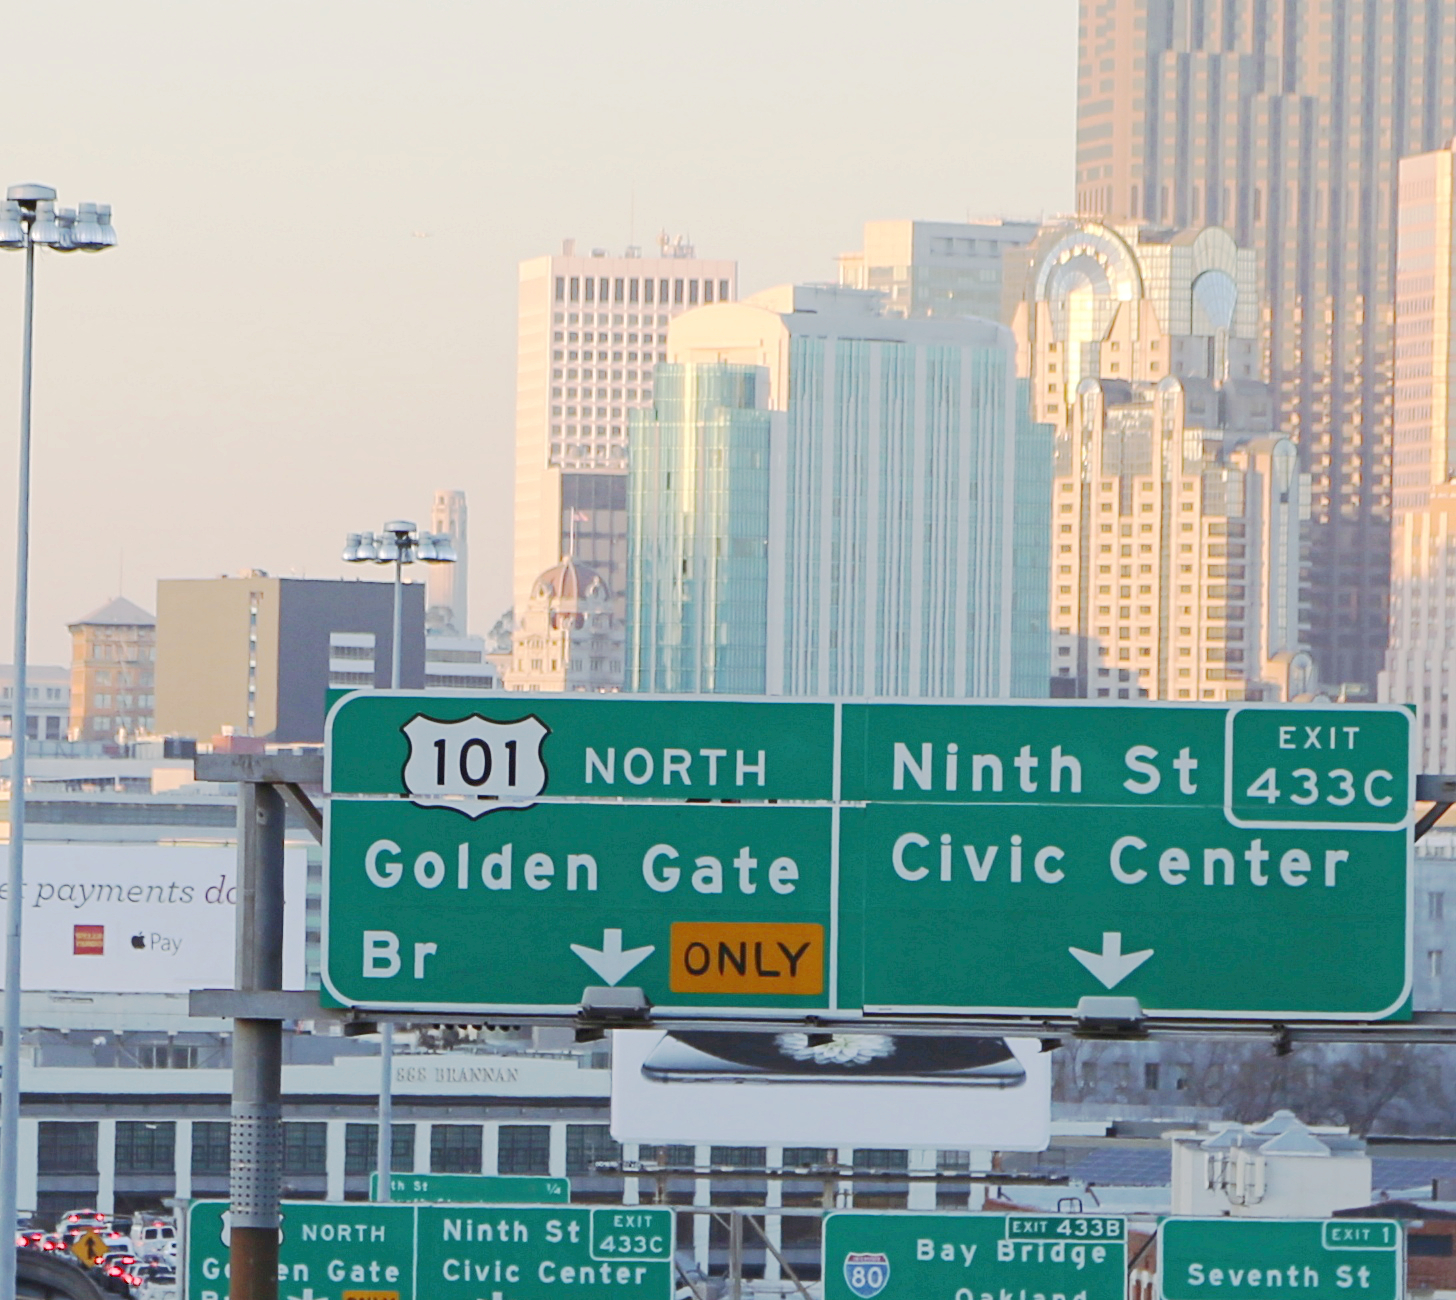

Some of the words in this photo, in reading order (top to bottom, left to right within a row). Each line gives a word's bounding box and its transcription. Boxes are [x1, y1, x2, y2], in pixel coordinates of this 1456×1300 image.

[1277, 724, 1361, 752] EXIT
[429, 738, 523, 789] 101
[582, 746, 768, 788] NORTH
[892, 742, 1085, 797] Ninth
[1124, 743, 1200, 798] St
[1244, 767, 1395, 809] 433C
[364, 839, 600, 894] Golden
[641, 843, 801, 896] Gate
[891, 832, 1067, 887] Civic
[1108, 835, 1352, 889] Center
[33, 878, 196, 908] payments
[150, 932, 182, 956] Pay
[361, 930, 438, 980] Br
[683, 939, 811, 980] ONLY
[435, 1067, 520, 1083] BRANNAN
[413, 1181, 428, 1192] St
[301, 1224, 386, 1243] NORTH
[444, 1218, 529, 1243] Ninth
[545, 1218, 581, 1243] St
[613, 1215, 653, 1229] EXIT
[1011, 1221, 1049, 1234] EXIT
[1056, 1219, 1121, 1238] 433B
[1330, 1228, 1371, 1242] EXIT
[1380, 1227, 1390, 1243] 1
[599, 1235, 663, 1254] 433C
[915, 1238, 978, 1267] Bay
[996, 1240, 1108, 1271] Bridge
[202, 1257, 310, 1282] Gen
[327, 1260, 400, 1283] Gate
[444, 1259, 521, 1284] Civic
[537, 1260, 648, 1285] Center
[851, 1267, 884, 1288] 80
[1186, 1262, 1320, 1289] Seventh
[1335, 1264, 1372, 1289] St
